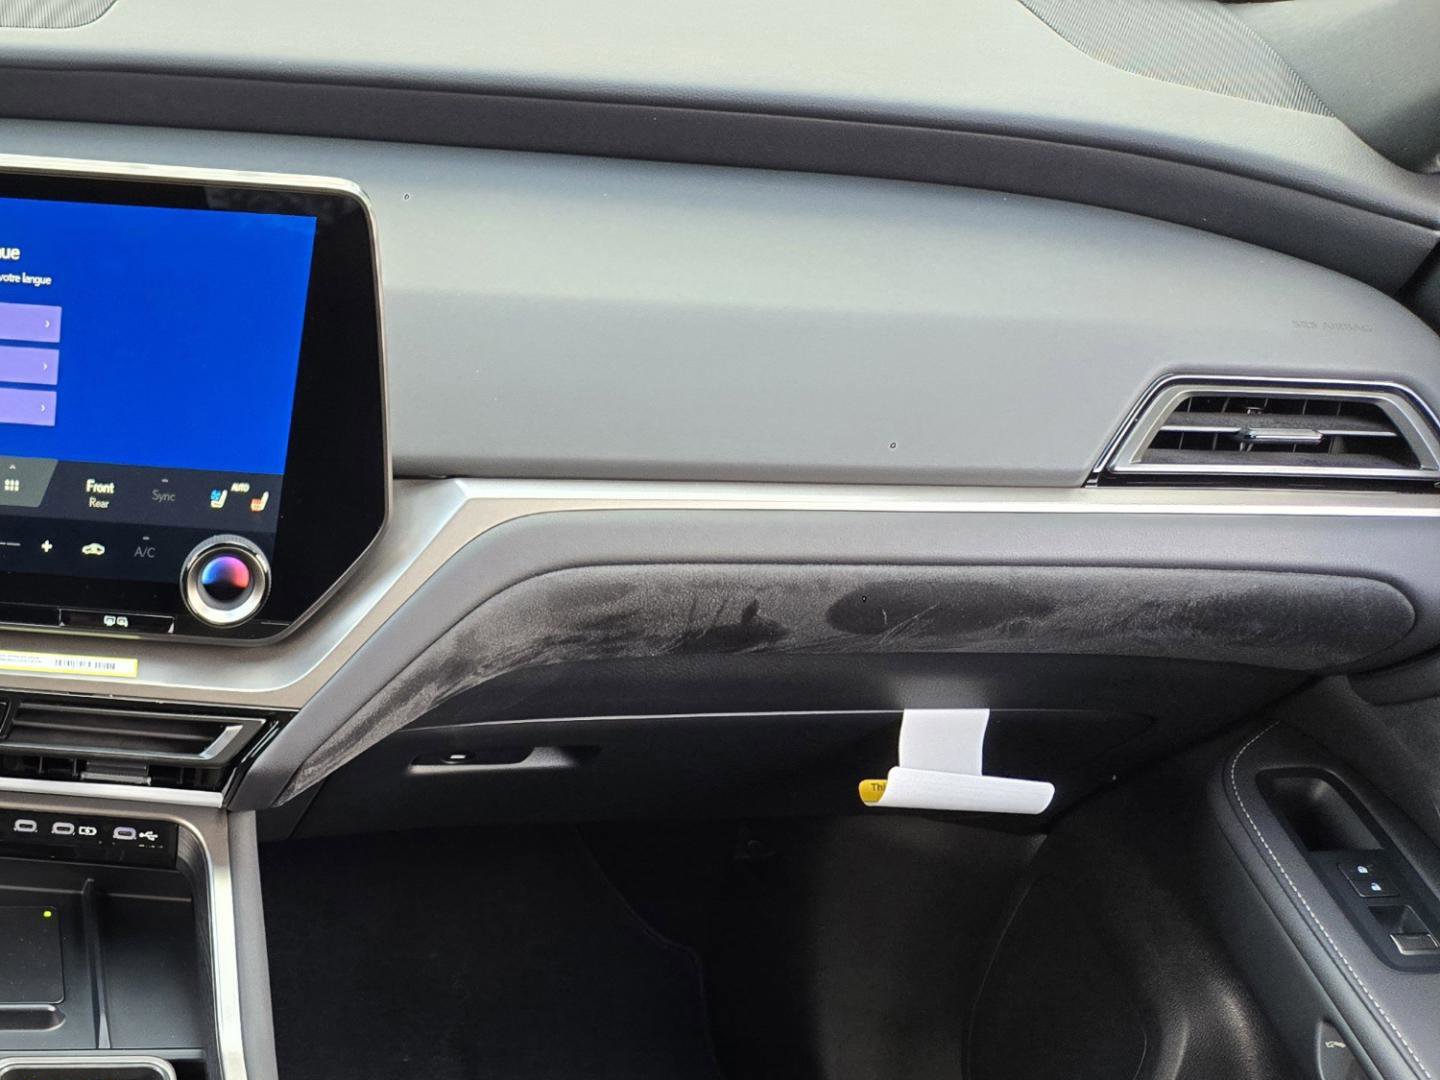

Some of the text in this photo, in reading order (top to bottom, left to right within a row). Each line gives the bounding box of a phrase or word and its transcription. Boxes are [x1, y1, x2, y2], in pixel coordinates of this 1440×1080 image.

[21, 272, 53, 287] langue
[85, 478, 115, 495] Front
[230, 482, 251, 493] AUTO
[151, 489, 176, 503] Sync
[88, 497, 110, 509] Rear
[134, 546, 157, 559] A/C
